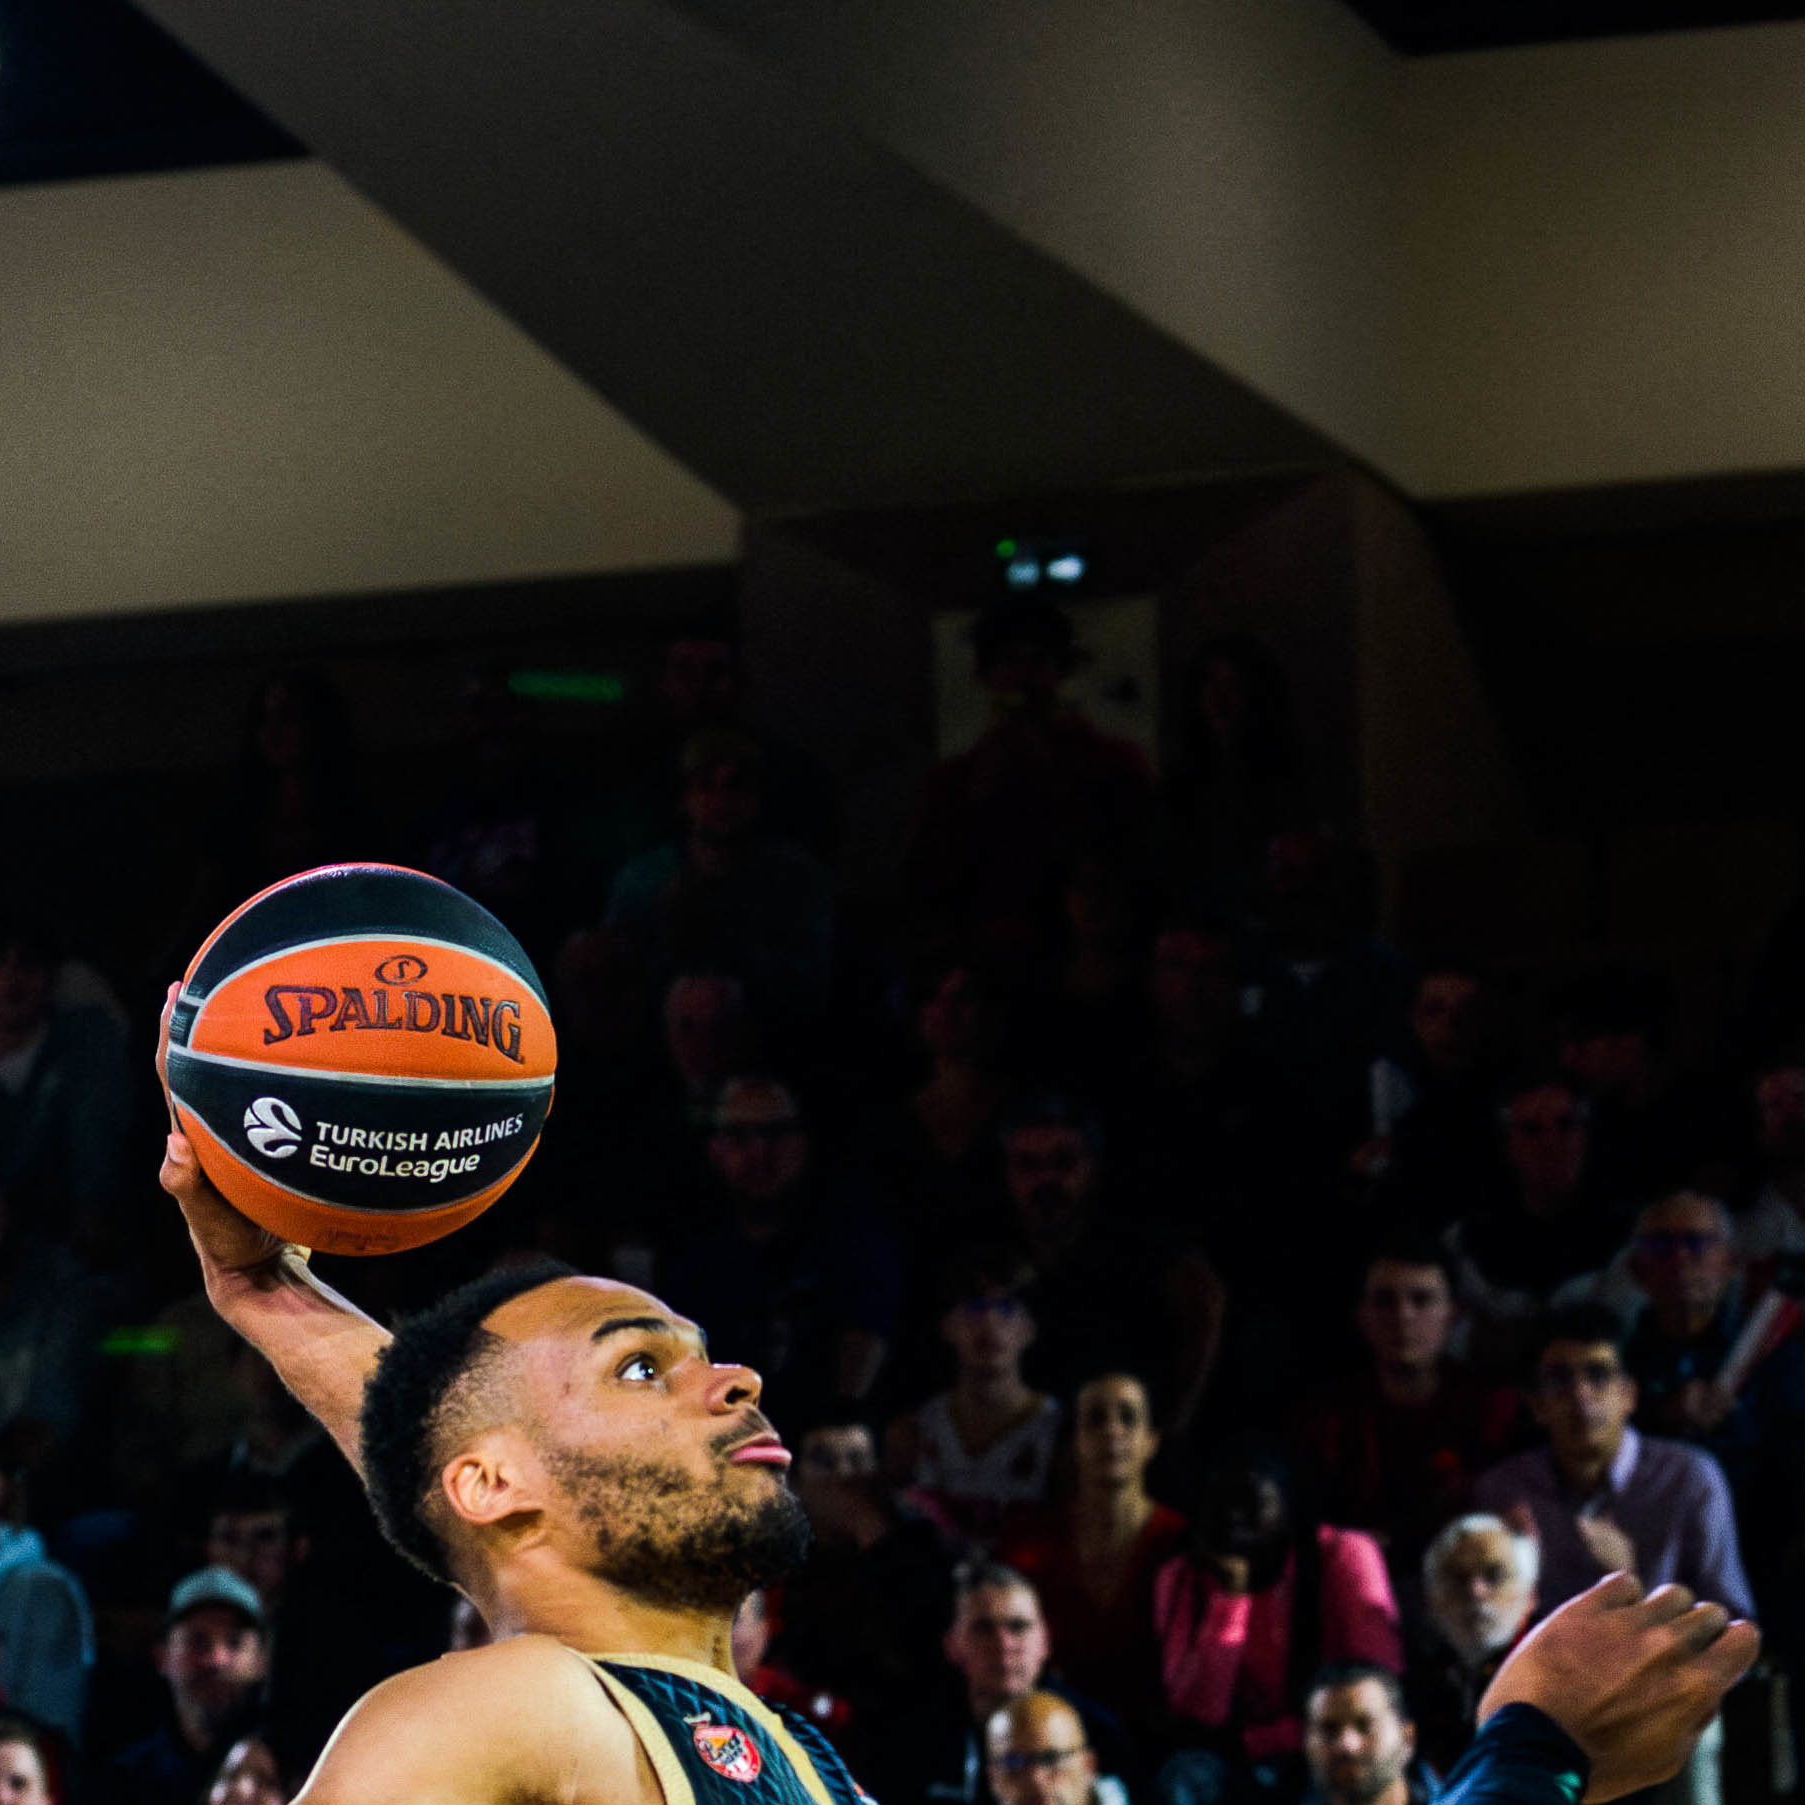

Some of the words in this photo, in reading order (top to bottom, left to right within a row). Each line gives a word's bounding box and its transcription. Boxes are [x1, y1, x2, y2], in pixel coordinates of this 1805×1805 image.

[263, 983, 526, 1065] SPALDING
[315, 1120, 428, 1152] TURKISH
[433, 1112, 524, 1152] AIRLINES
[309, 1145, 481, 1183] EuroLeague
